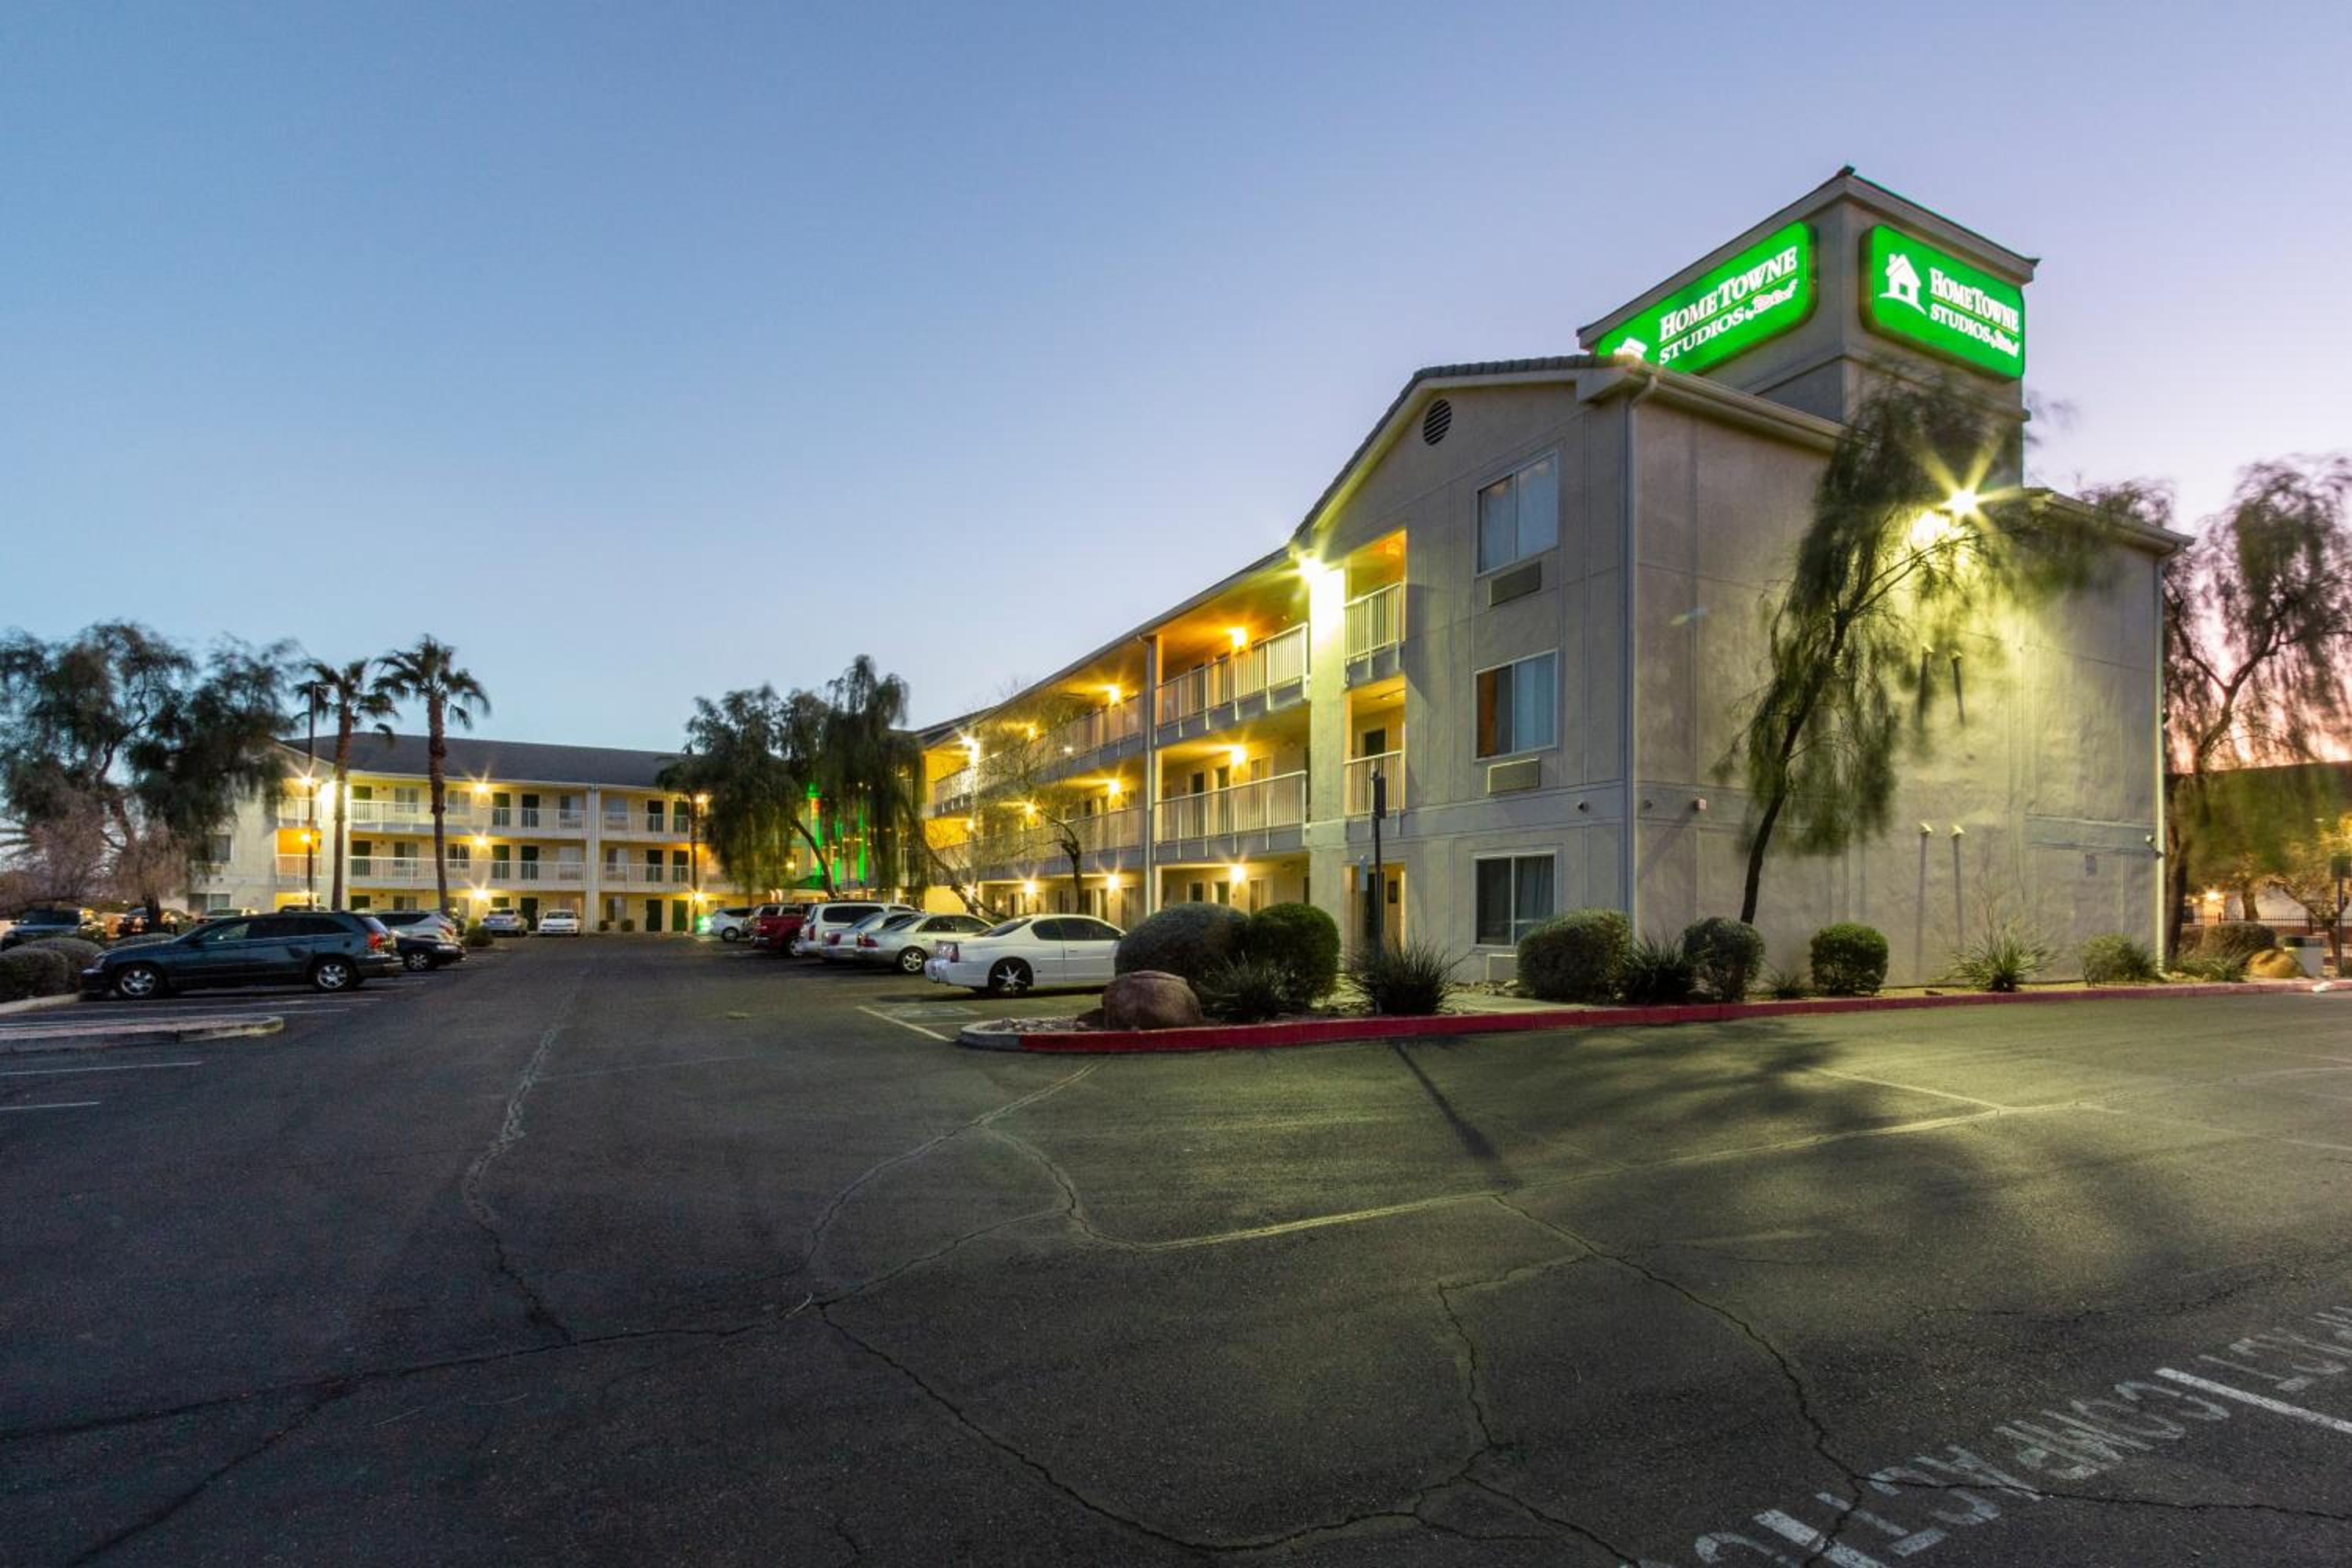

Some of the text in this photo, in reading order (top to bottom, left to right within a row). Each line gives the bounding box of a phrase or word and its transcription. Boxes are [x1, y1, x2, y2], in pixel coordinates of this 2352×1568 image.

[1659, 307, 1745, 365] STUDIOS
[1930, 303, 1991, 343] STUDIOS
[1816, 1380, 2231, 1558] COMPACT
